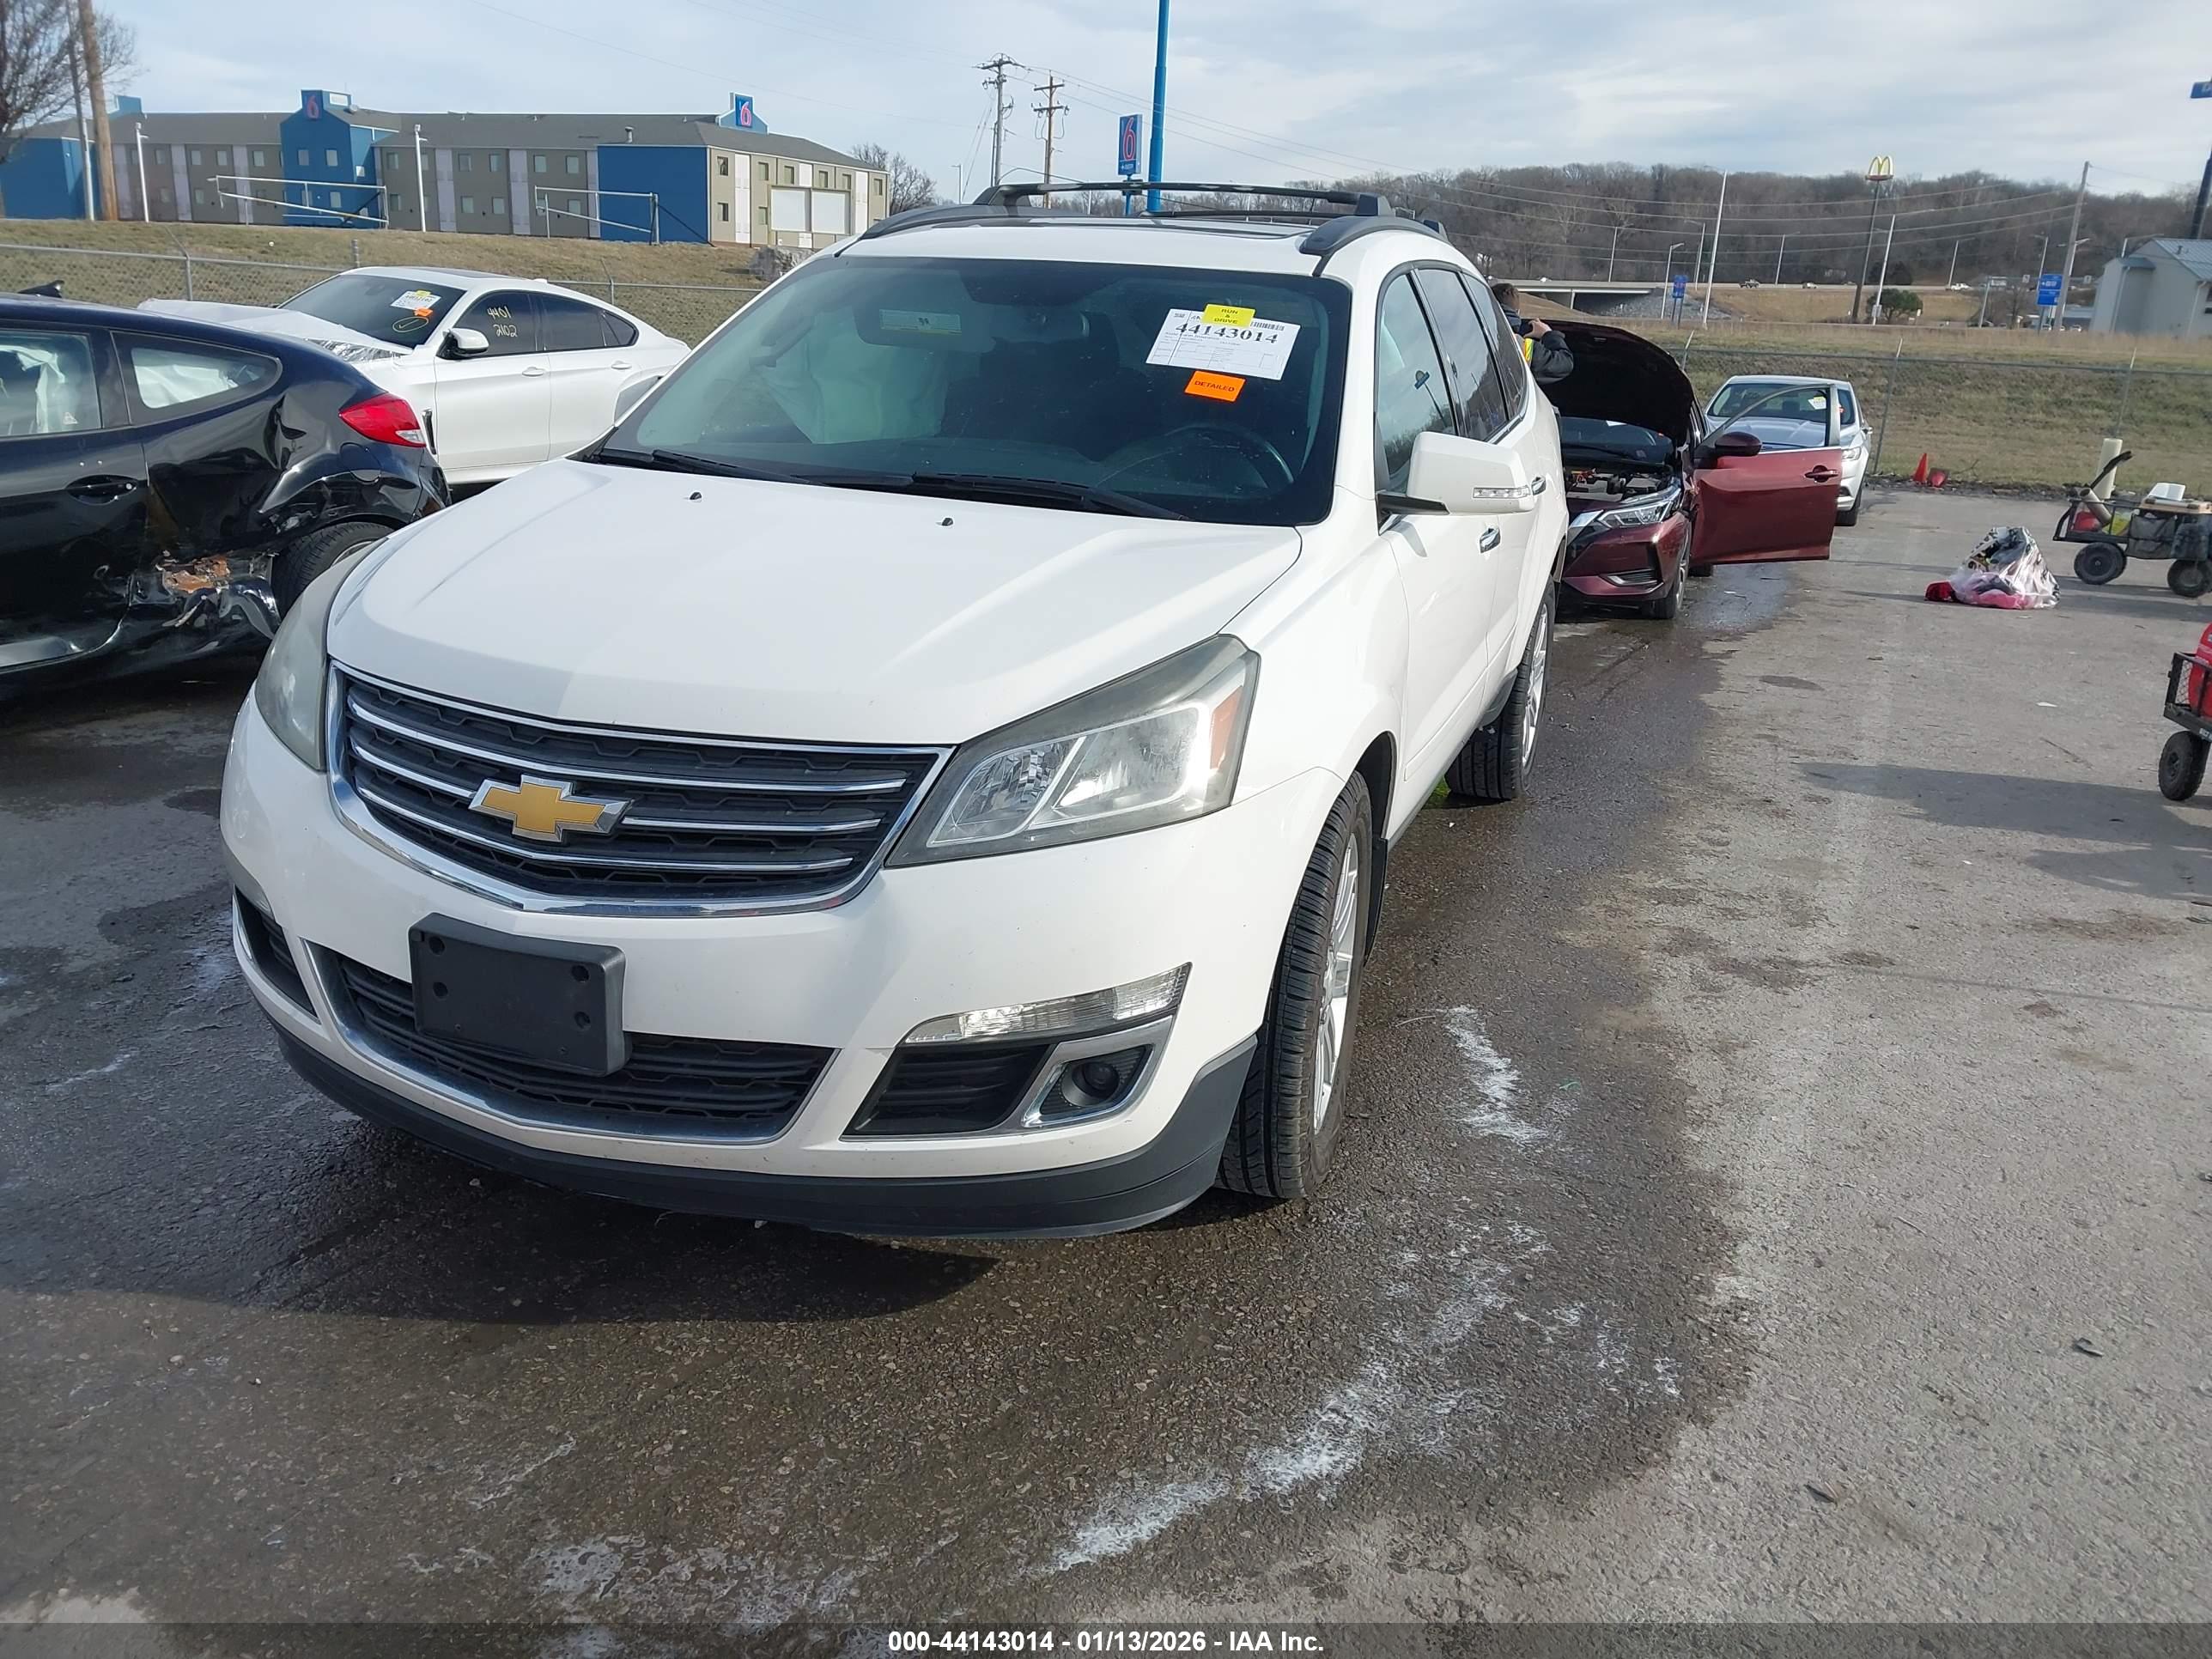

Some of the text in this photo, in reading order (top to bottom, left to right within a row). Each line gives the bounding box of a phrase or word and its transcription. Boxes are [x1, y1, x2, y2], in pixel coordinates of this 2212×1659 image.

[740, 101, 752, 127] 6
[1123, 117, 1136, 161] 6
[487, 306, 512, 319] 4401
[1176, 323, 1279, 343] 44143014
[1194, 380, 1235, 392] DETAILED
